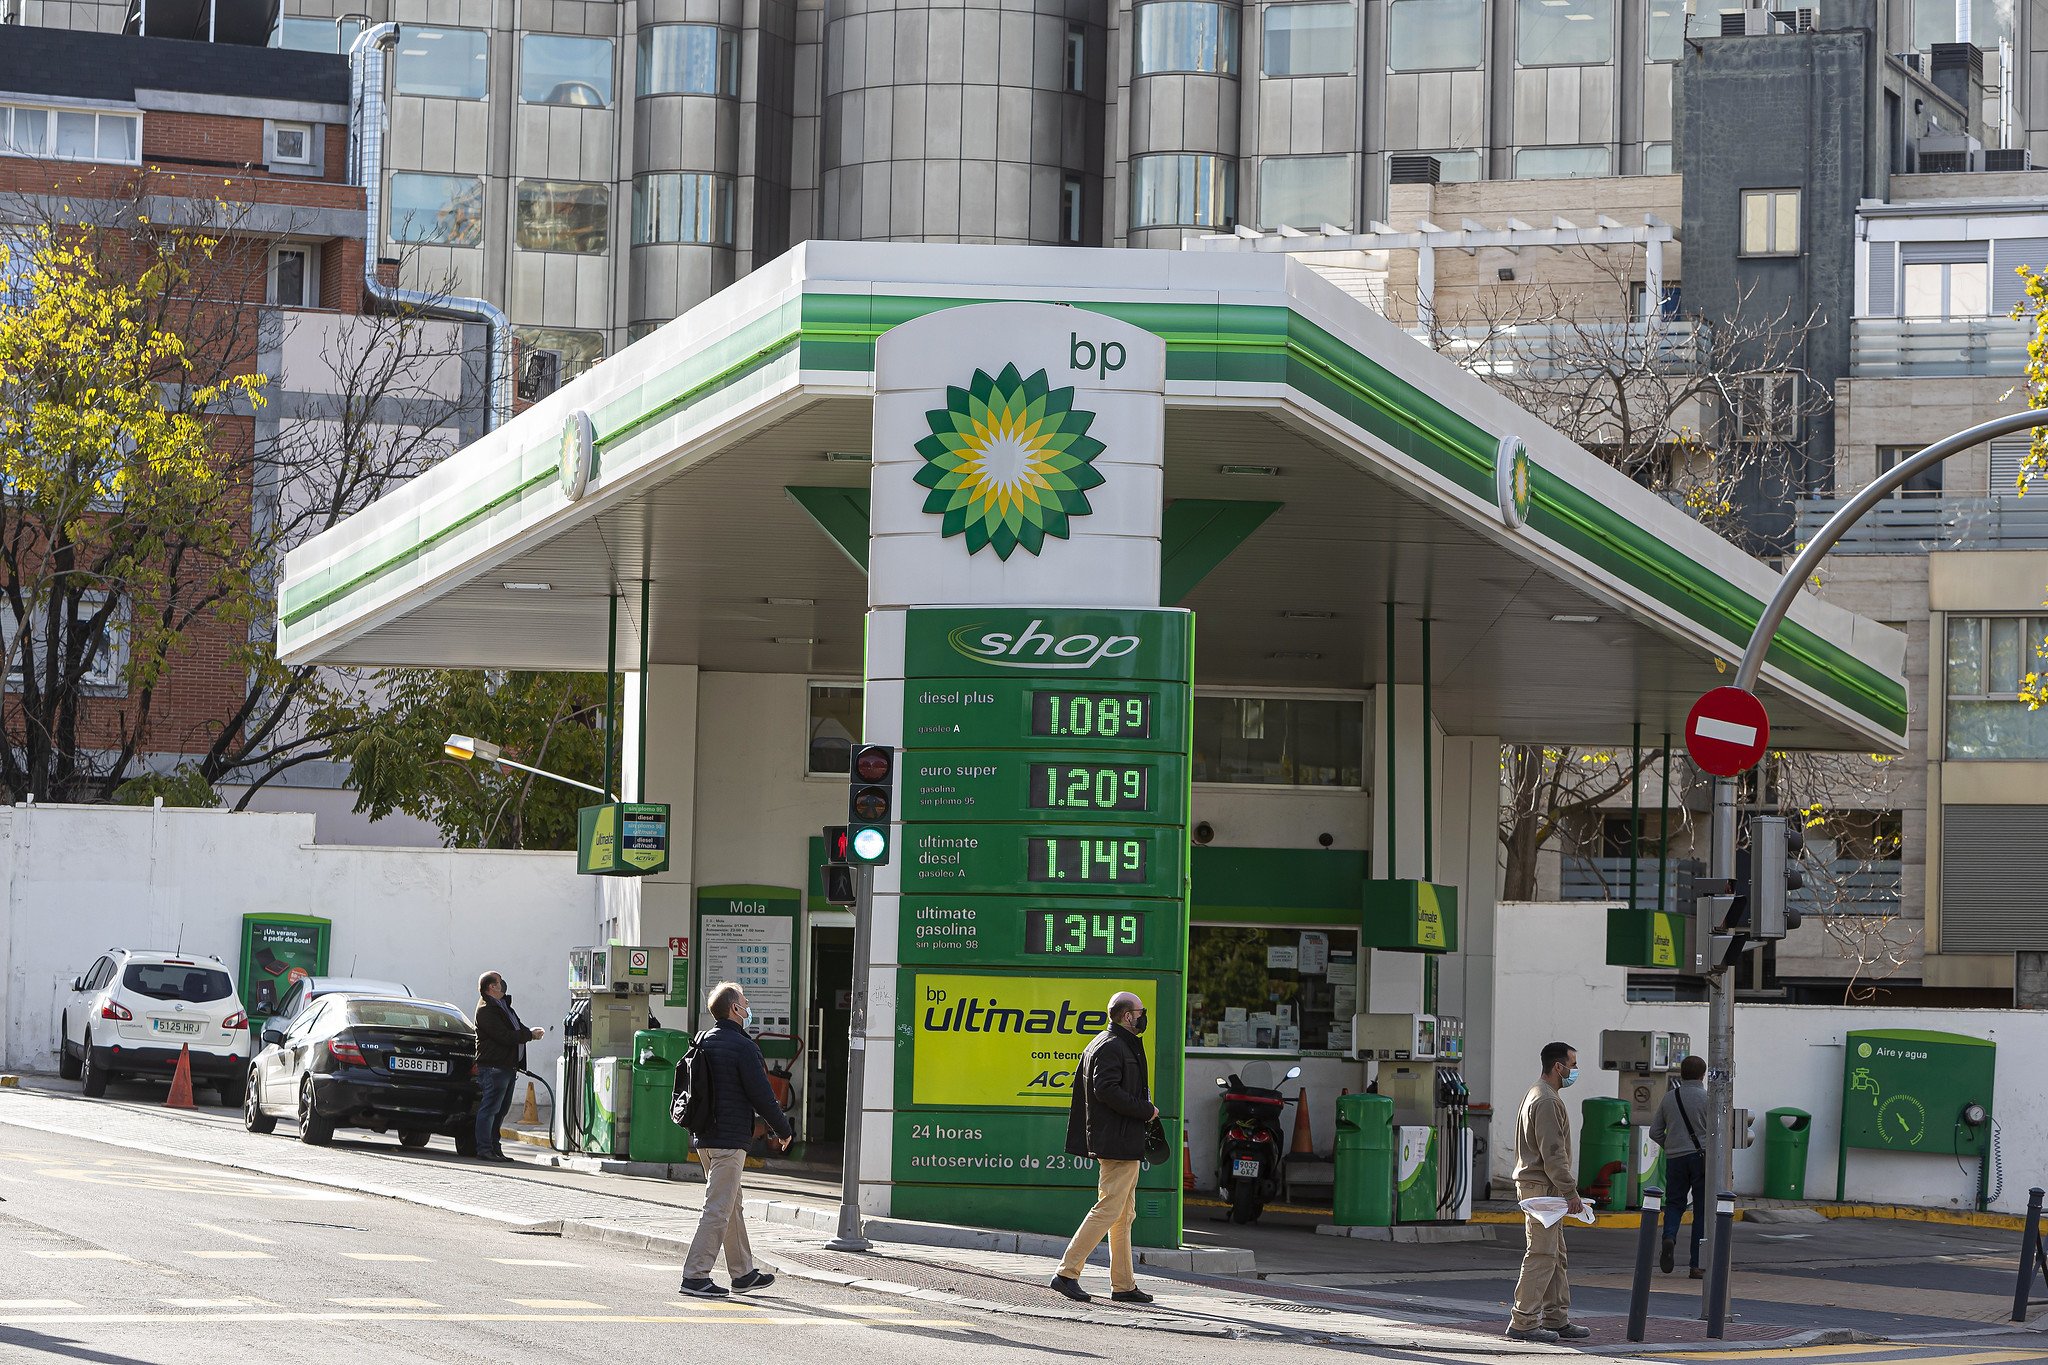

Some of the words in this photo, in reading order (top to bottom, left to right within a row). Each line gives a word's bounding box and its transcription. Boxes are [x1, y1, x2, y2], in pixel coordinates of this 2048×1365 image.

[1069, 332, 1127, 380] bp
[981, 619, 1141, 669] shop
[919, 691, 959, 704] diesel
[964, 691, 995, 706] plus
[1050, 696, 1142, 736] 1.089
[953, 724, 960, 732] A
[920, 766, 952, 776] euro
[956, 766, 997, 778] super
[920, 785, 956, 795] gasolina
[1047, 768, 1140, 808] 1.209
[920, 797, 932, 805] sin
[934, 797, 962, 807] plomo
[964, 796, 975, 805] 95
[919, 835, 979, 849] ultimate
[918, 851, 960, 864] diesel
[1047, 839, 1140, 879] 1.149
[957, 869, 966, 878] A
[730, 901, 766, 914] Mola
[916, 906, 977, 920] ultimate
[916, 922, 977, 938] gasolina
[1044, 914, 1137, 954] 1.349
[916, 940, 929, 949] sin
[932, 940, 962, 950] plomo
[965, 940, 979, 949] 98
[926, 985, 946, 1004] bp
[924, 998, 1108, 1035] ultimate
[160, 1022, 181, 1031] 5125
[183, 1024, 200, 1033] HRJ
[1031, 1051, 1051, 1059] con
[1876, 1047, 1896, 1057] Aire
[1897, 1050, 1904, 1059] y
[1905, 1051, 1928, 1060] agua
[398, 1059, 423, 1070] 3686
[425, 1061, 445, 1072] FBT
[912, 1125, 930, 1139] 24
[936, 1125, 983, 1140] horas
[911, 1153, 1014, 1169] autoservicio
[1020, 1154, 1040, 1169] de
[1046, 1155, 1094, 1170] 23:00
[1239, 1161, 1258, 1169] 9032
